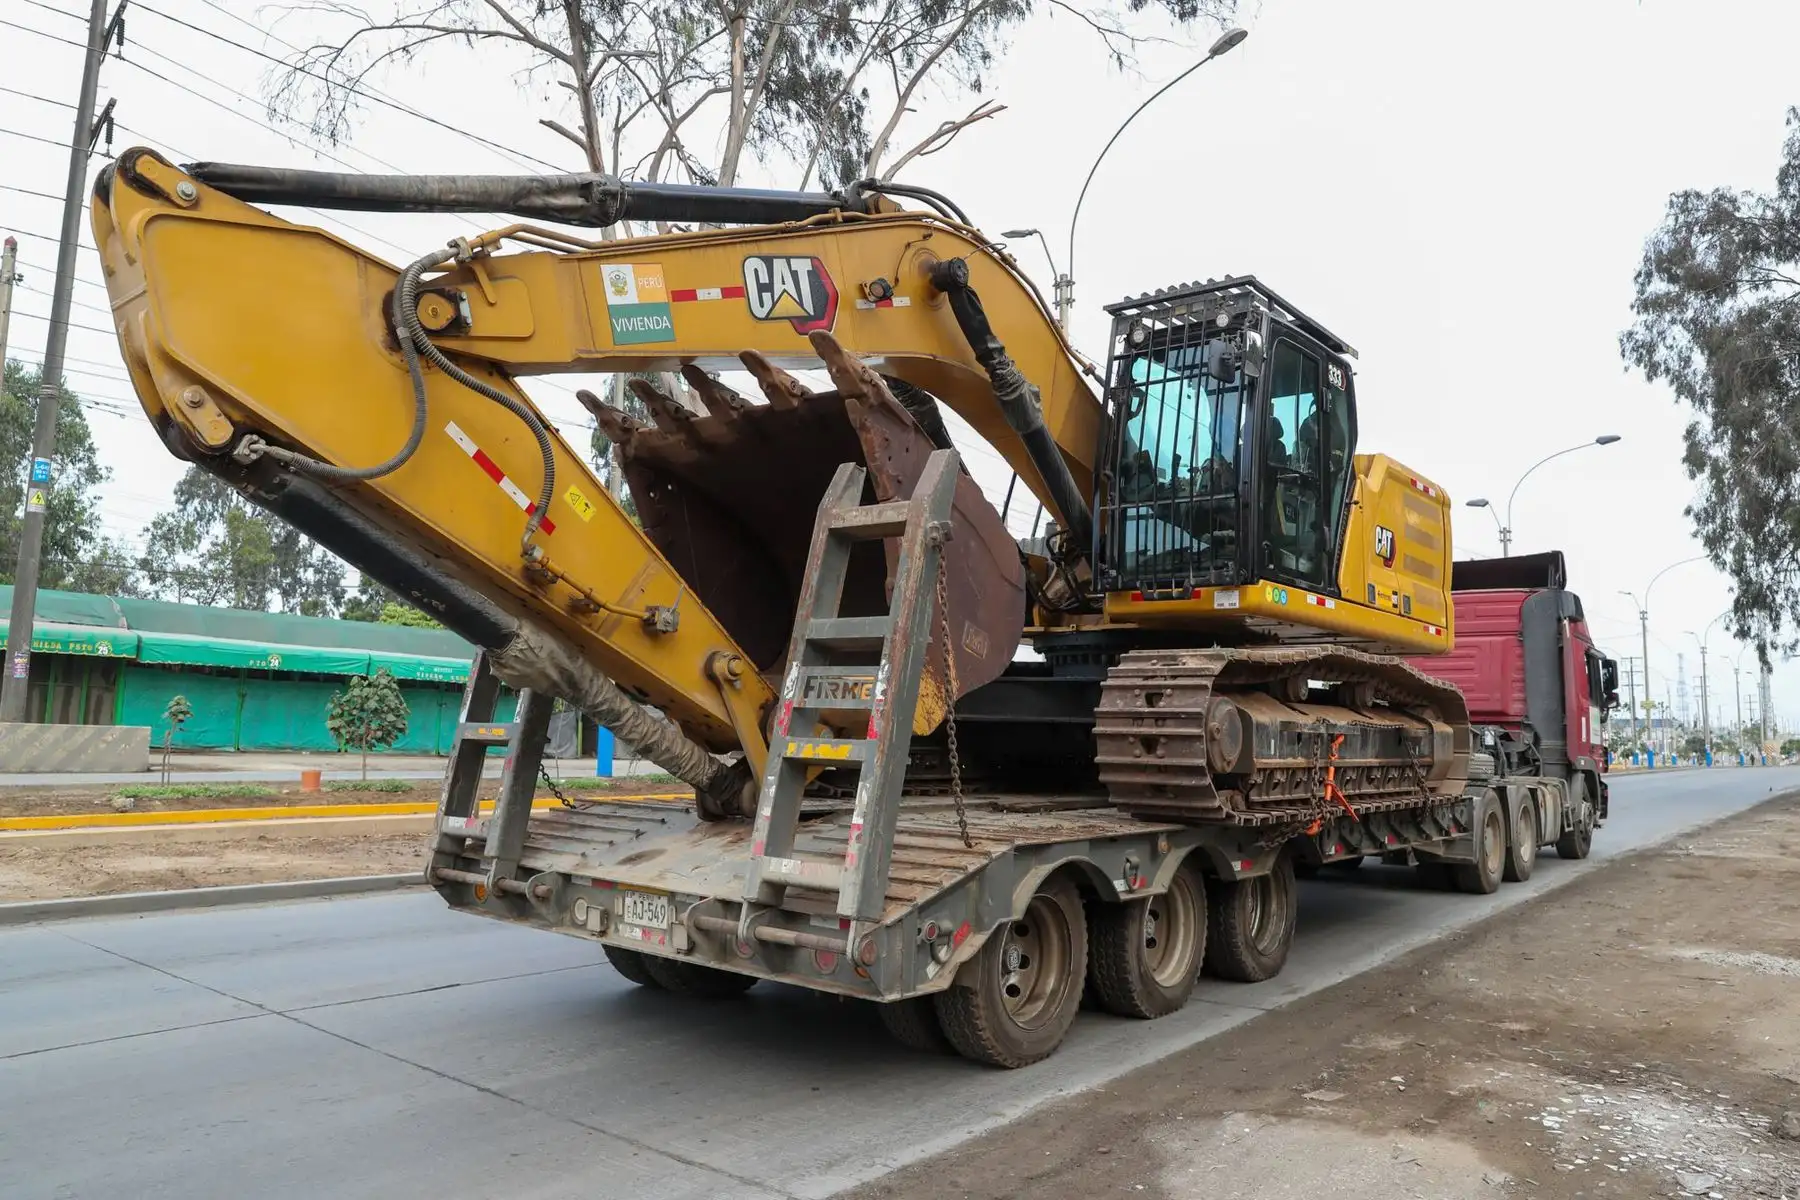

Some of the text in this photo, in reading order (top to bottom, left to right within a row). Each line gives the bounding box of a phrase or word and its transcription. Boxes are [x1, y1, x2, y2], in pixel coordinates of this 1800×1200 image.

[637, 273, 663, 289] PERÚ
[744, 257, 813, 318] CAT
[612, 315, 671, 333] VIVIENDA
[1376, 526, 1392, 559] CAT
[98, 645, 109, 655] 25
[803, 675, 874, 700] FIRME
